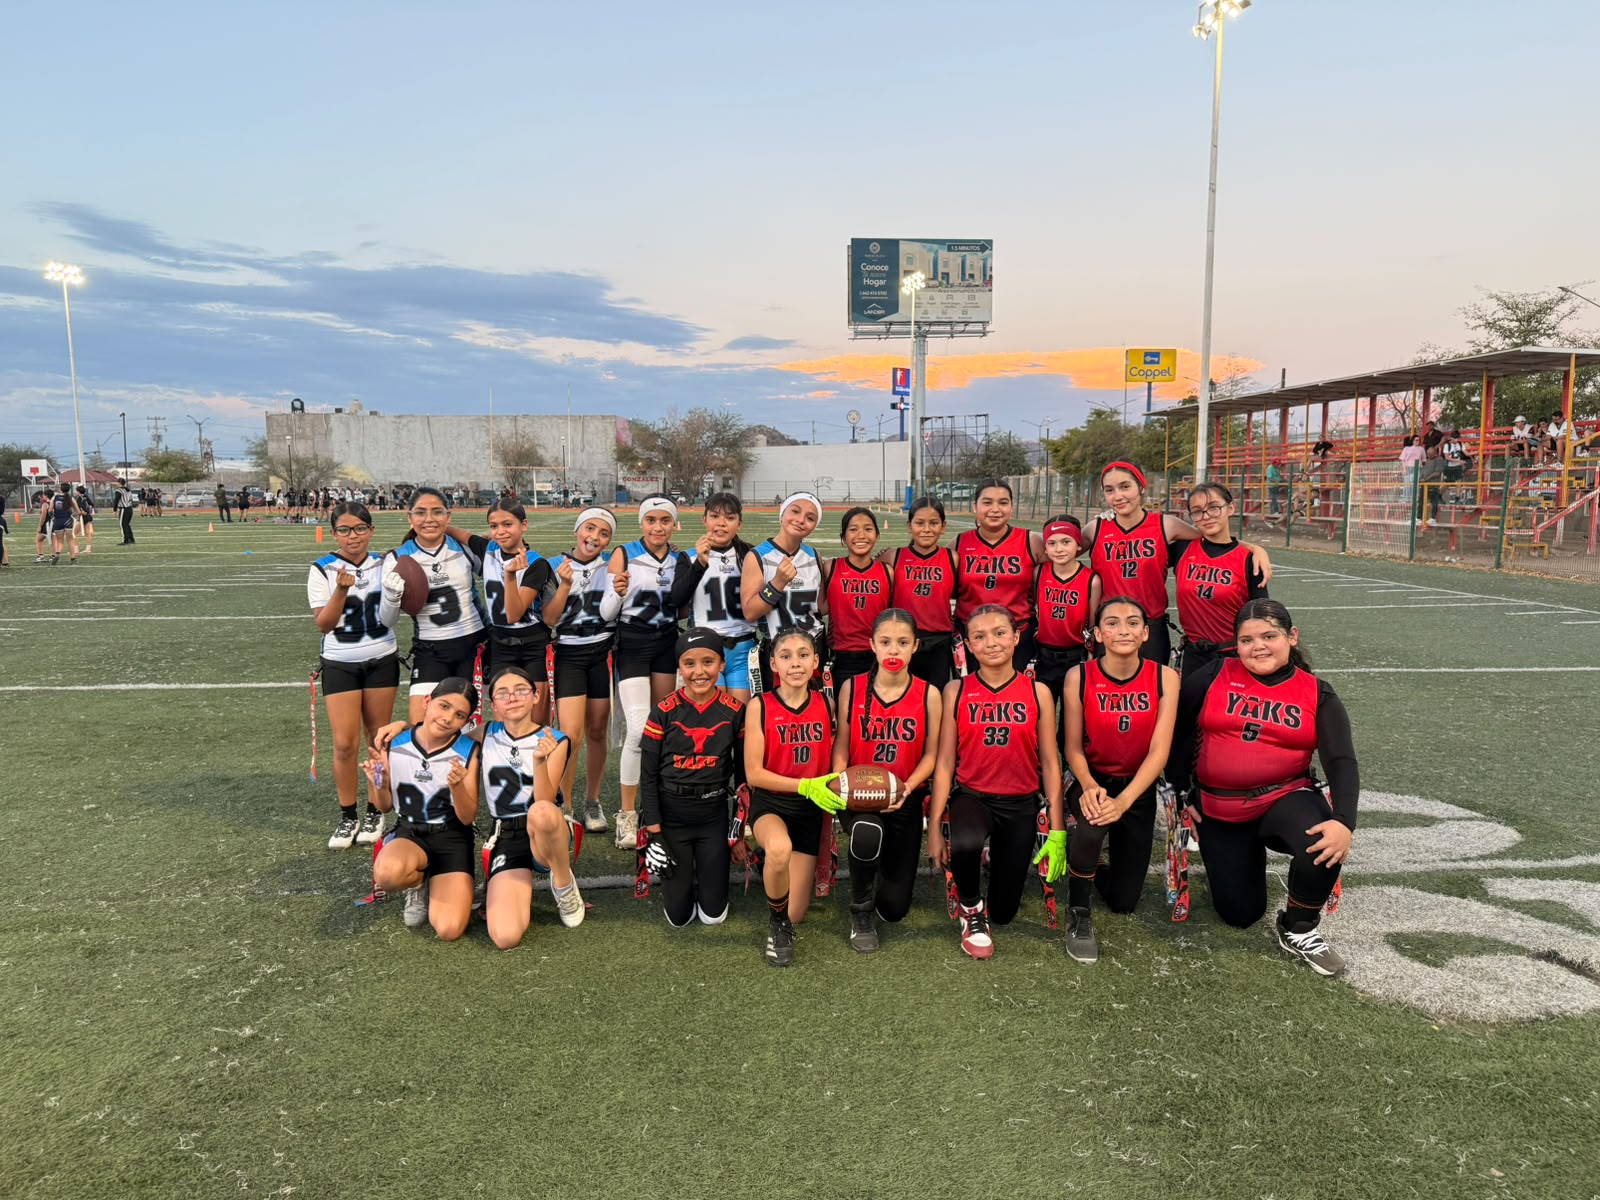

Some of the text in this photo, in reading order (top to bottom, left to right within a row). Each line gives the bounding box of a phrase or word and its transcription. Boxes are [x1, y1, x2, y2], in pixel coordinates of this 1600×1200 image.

[860, 263, 889, 271] Conoce
[863, 278, 887, 287] Hogar
[1129, 366, 1173, 380] Coppel
[1103, 538, 1156, 561] YAKS
[903, 565, 943, 582] YAKS
[964, 554, 1021, 575] YAKS
[1120, 561, 1138, 579] 12
[1186, 563, 1232, 586] YAKS
[841, 578, 880, 595] YAKS
[913, 583, 932, 597] 45
[984, 574, 997, 590] 6
[1196, 584, 1215, 600] 14
[426, 585, 462, 627] 3
[854, 595, 867, 610] 11
[1044, 585, 1080, 607] YAKS
[1051, 605, 1067, 620] 25
[1095, 691, 1150, 712] YAKS
[1225, 691, 1302, 729] YAKS
[967, 702, 1027, 724] YAKS
[1117, 714, 1130, 732] 6
[777, 721, 824, 744] YAKS
[859, 715, 916, 742] YAKS
[983, 726, 1010, 747] 33
[1241, 721, 1262, 743] 5
[793, 745, 812, 765] 10
[873, 743, 898, 764] 26
